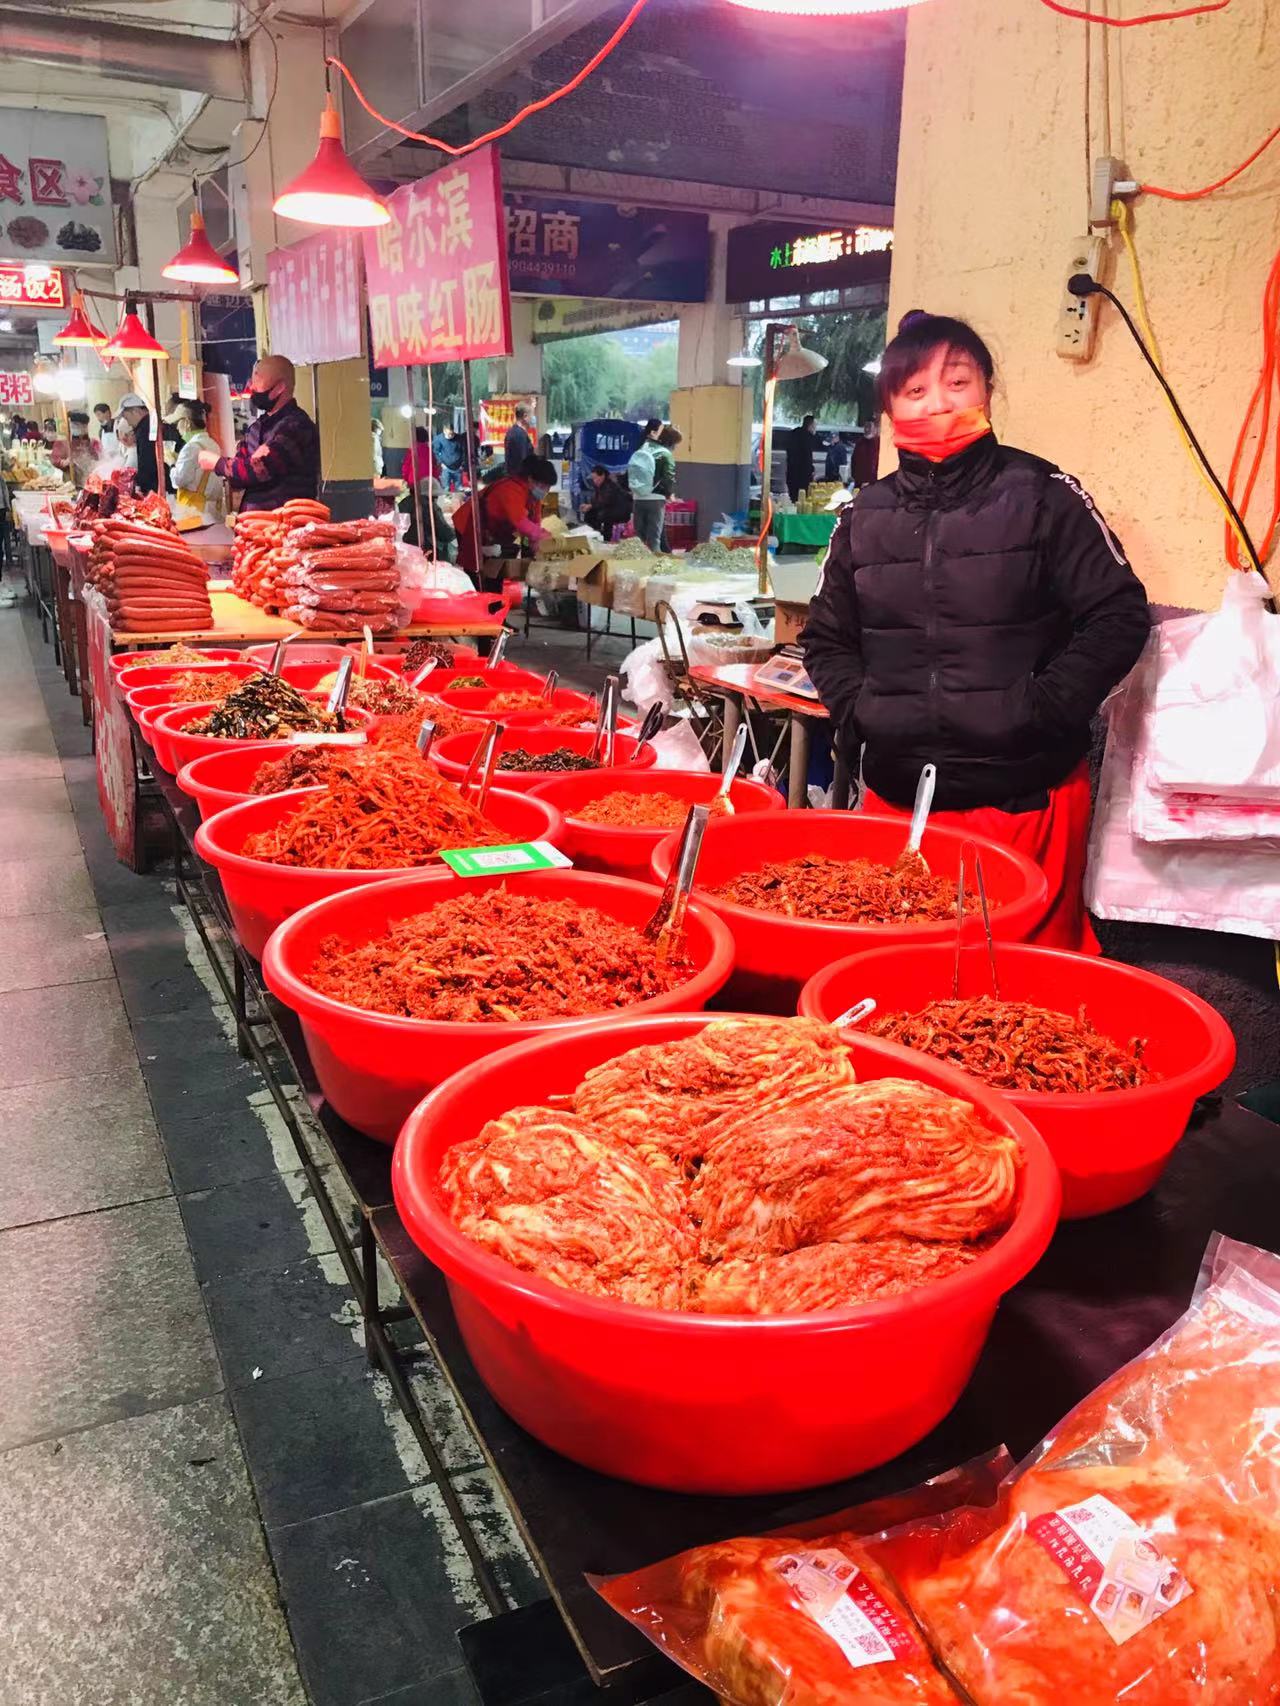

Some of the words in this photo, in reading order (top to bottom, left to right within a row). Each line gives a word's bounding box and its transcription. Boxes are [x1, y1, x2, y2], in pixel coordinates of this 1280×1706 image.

[376, 168, 474, 273] 哈尔滨
[503, 205, 581, 260] 招商
[508, 258, 576, 274] 904439110
[372, 261, 501, 360] 风味红肠
